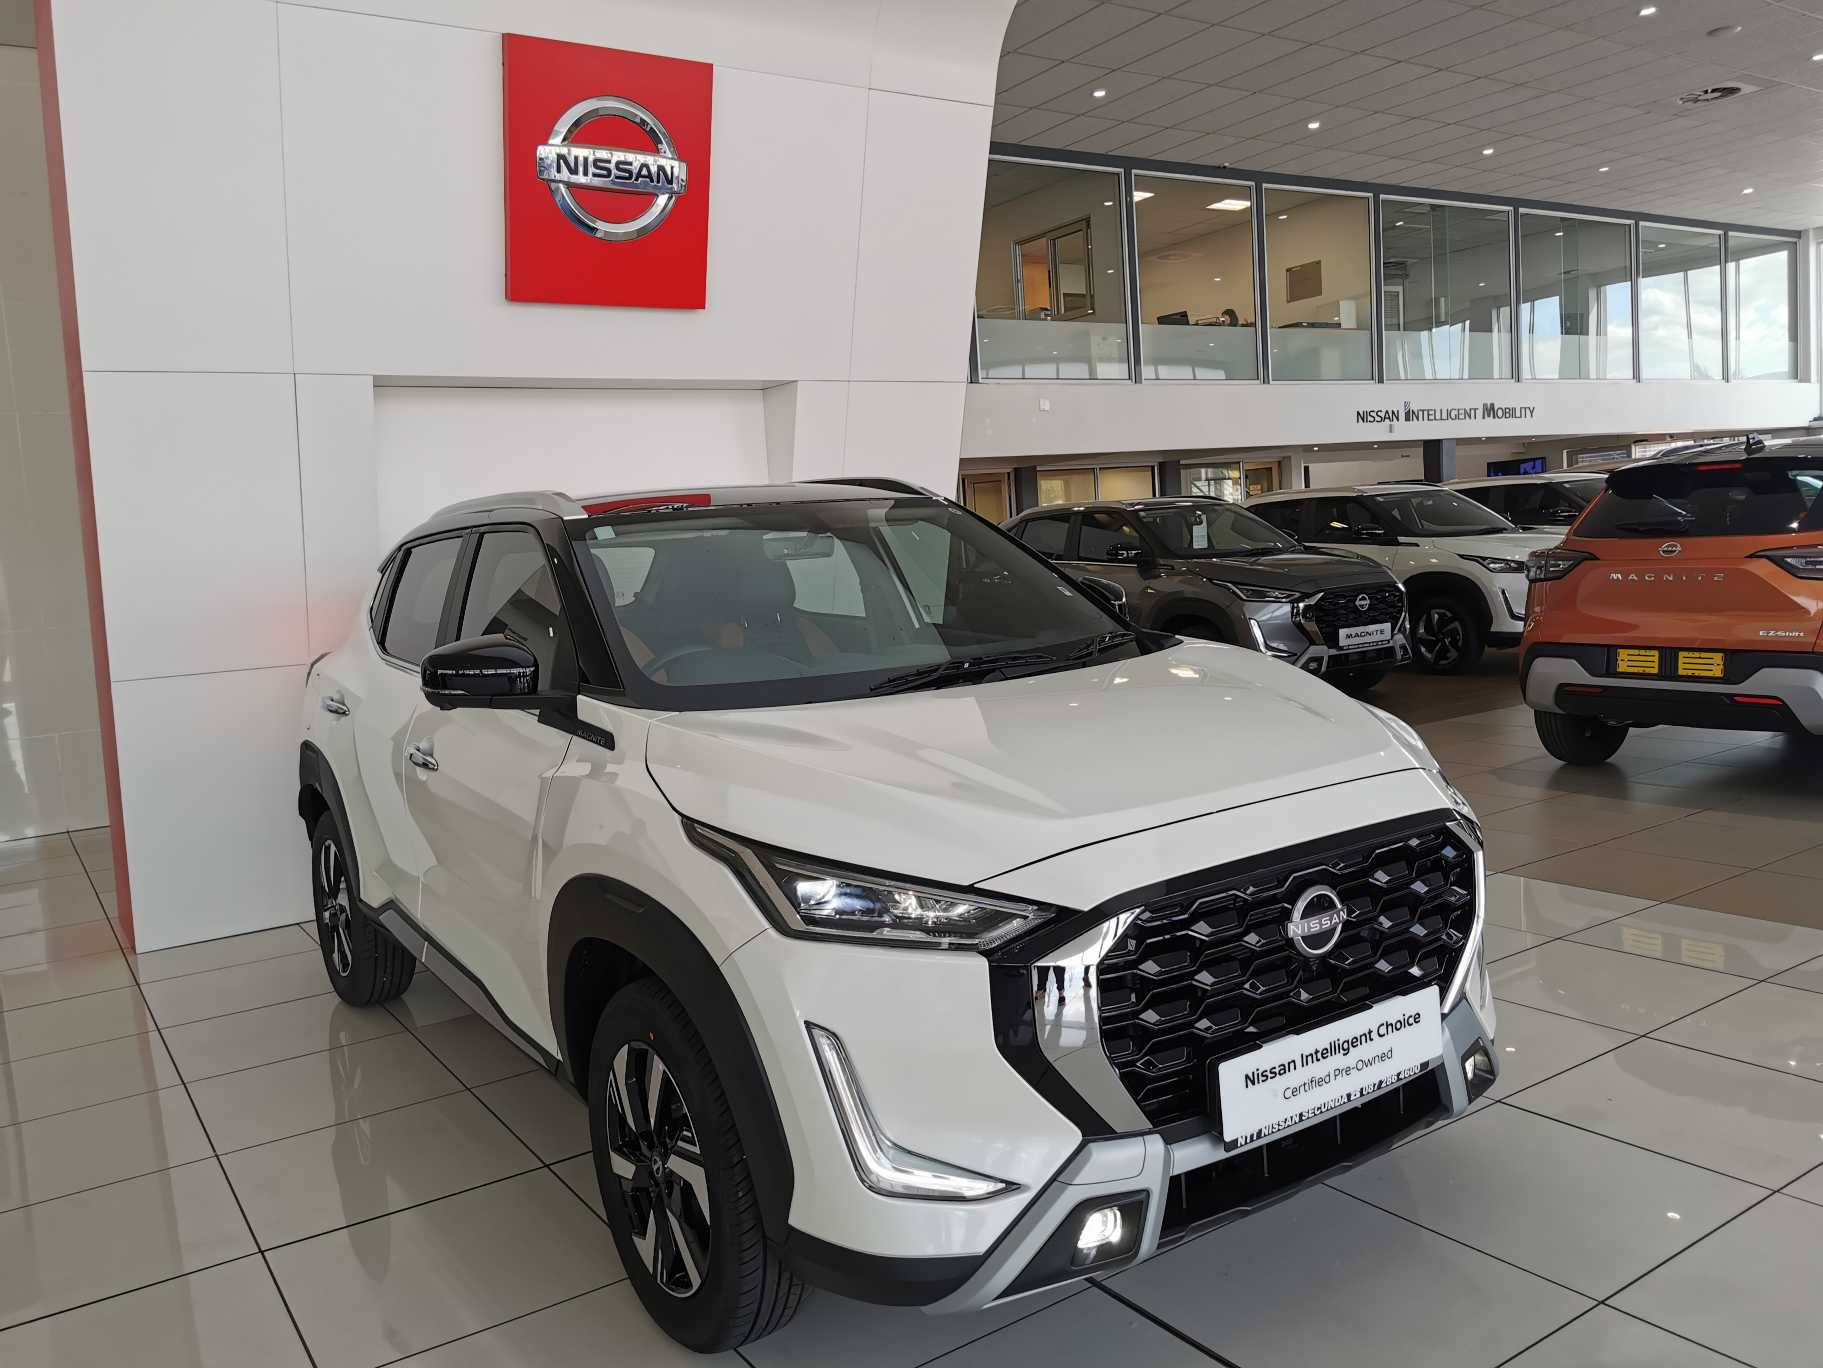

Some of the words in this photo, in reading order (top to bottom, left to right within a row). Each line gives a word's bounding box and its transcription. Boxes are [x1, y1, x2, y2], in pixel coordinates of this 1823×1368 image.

[556, 154, 675, 185] NISSAN
[1356, 409, 1400, 424] NISSAN
[1404, 401, 1479, 422] INTELLIGENT
[1482, 402, 1536, 420] MOBILITY
[1345, 628, 1385, 639] MAGNITE
[1290, 906, 1347, 935] NISSAN
[1244, 1058, 1298, 1089] Nissan
[1300, 1030, 1375, 1068] Intelligent
[1376, 1011, 1422, 1038] Choice
[1283, 1071, 1331, 1100] Certified
[1333, 1047, 1393, 1080] Pre-Owned
[1237, 1130, 1260, 1147] NTT
[1261, 1113, 1301, 1137] NISSAN
[1301, 1095, 1348, 1120] SECUNDA
